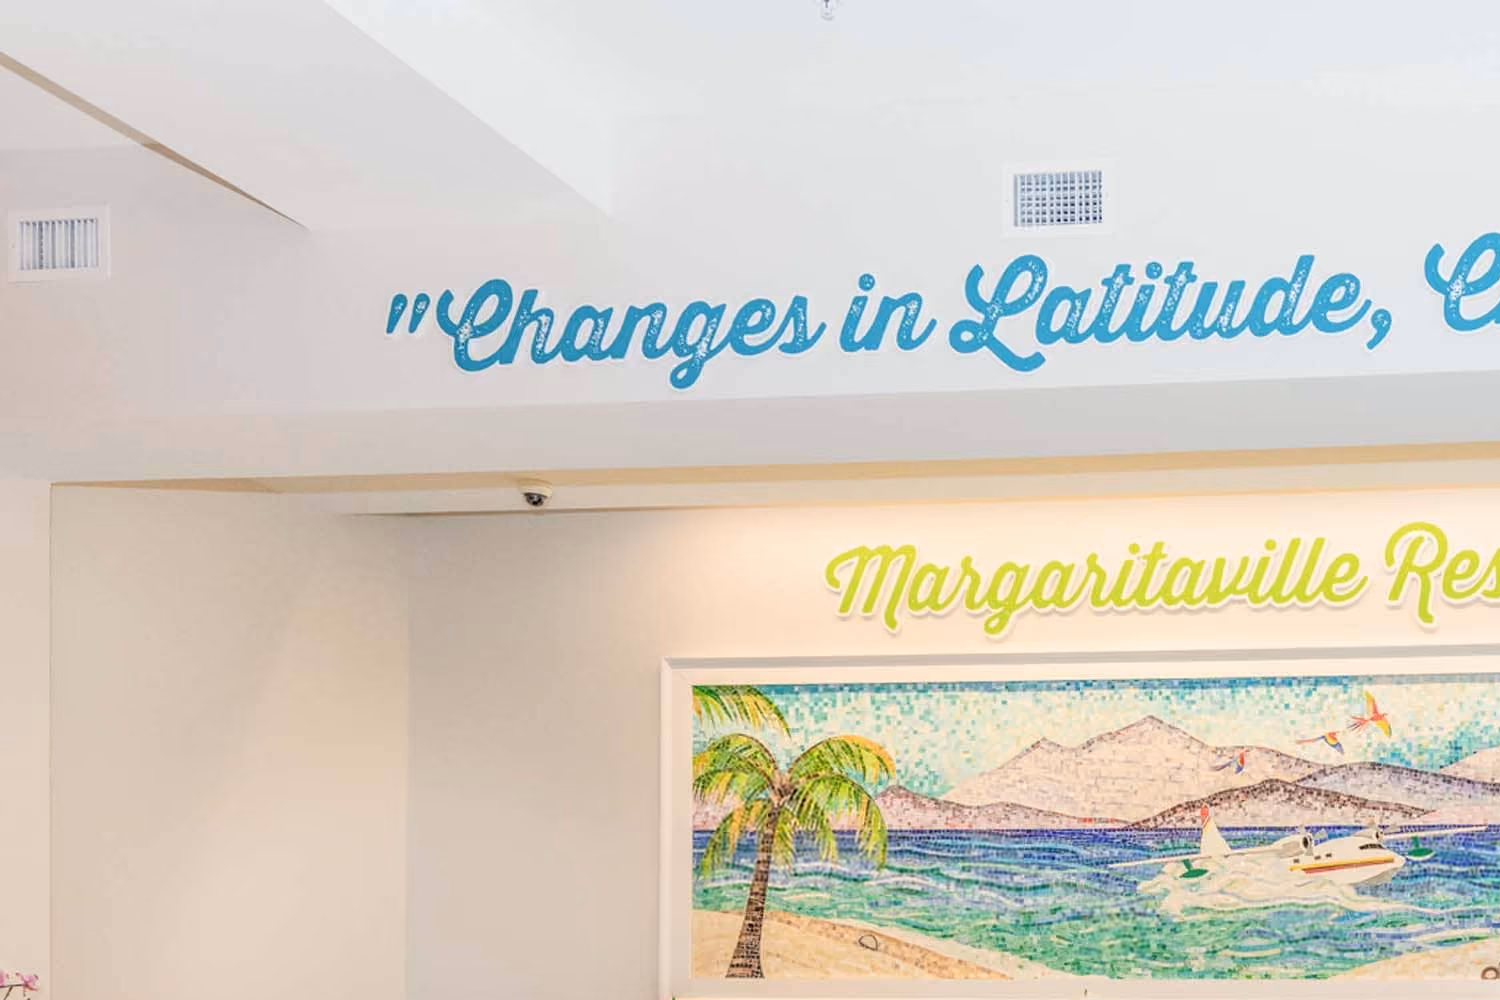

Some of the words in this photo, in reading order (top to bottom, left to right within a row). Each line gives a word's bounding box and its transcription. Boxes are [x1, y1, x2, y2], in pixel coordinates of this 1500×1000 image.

[386, 278, 828, 391] "Changes
[839, 273, 937, 354] in
[948, 254, 1393, 373] Latitude,
[825, 537, 1368, 636] Margaritaville
